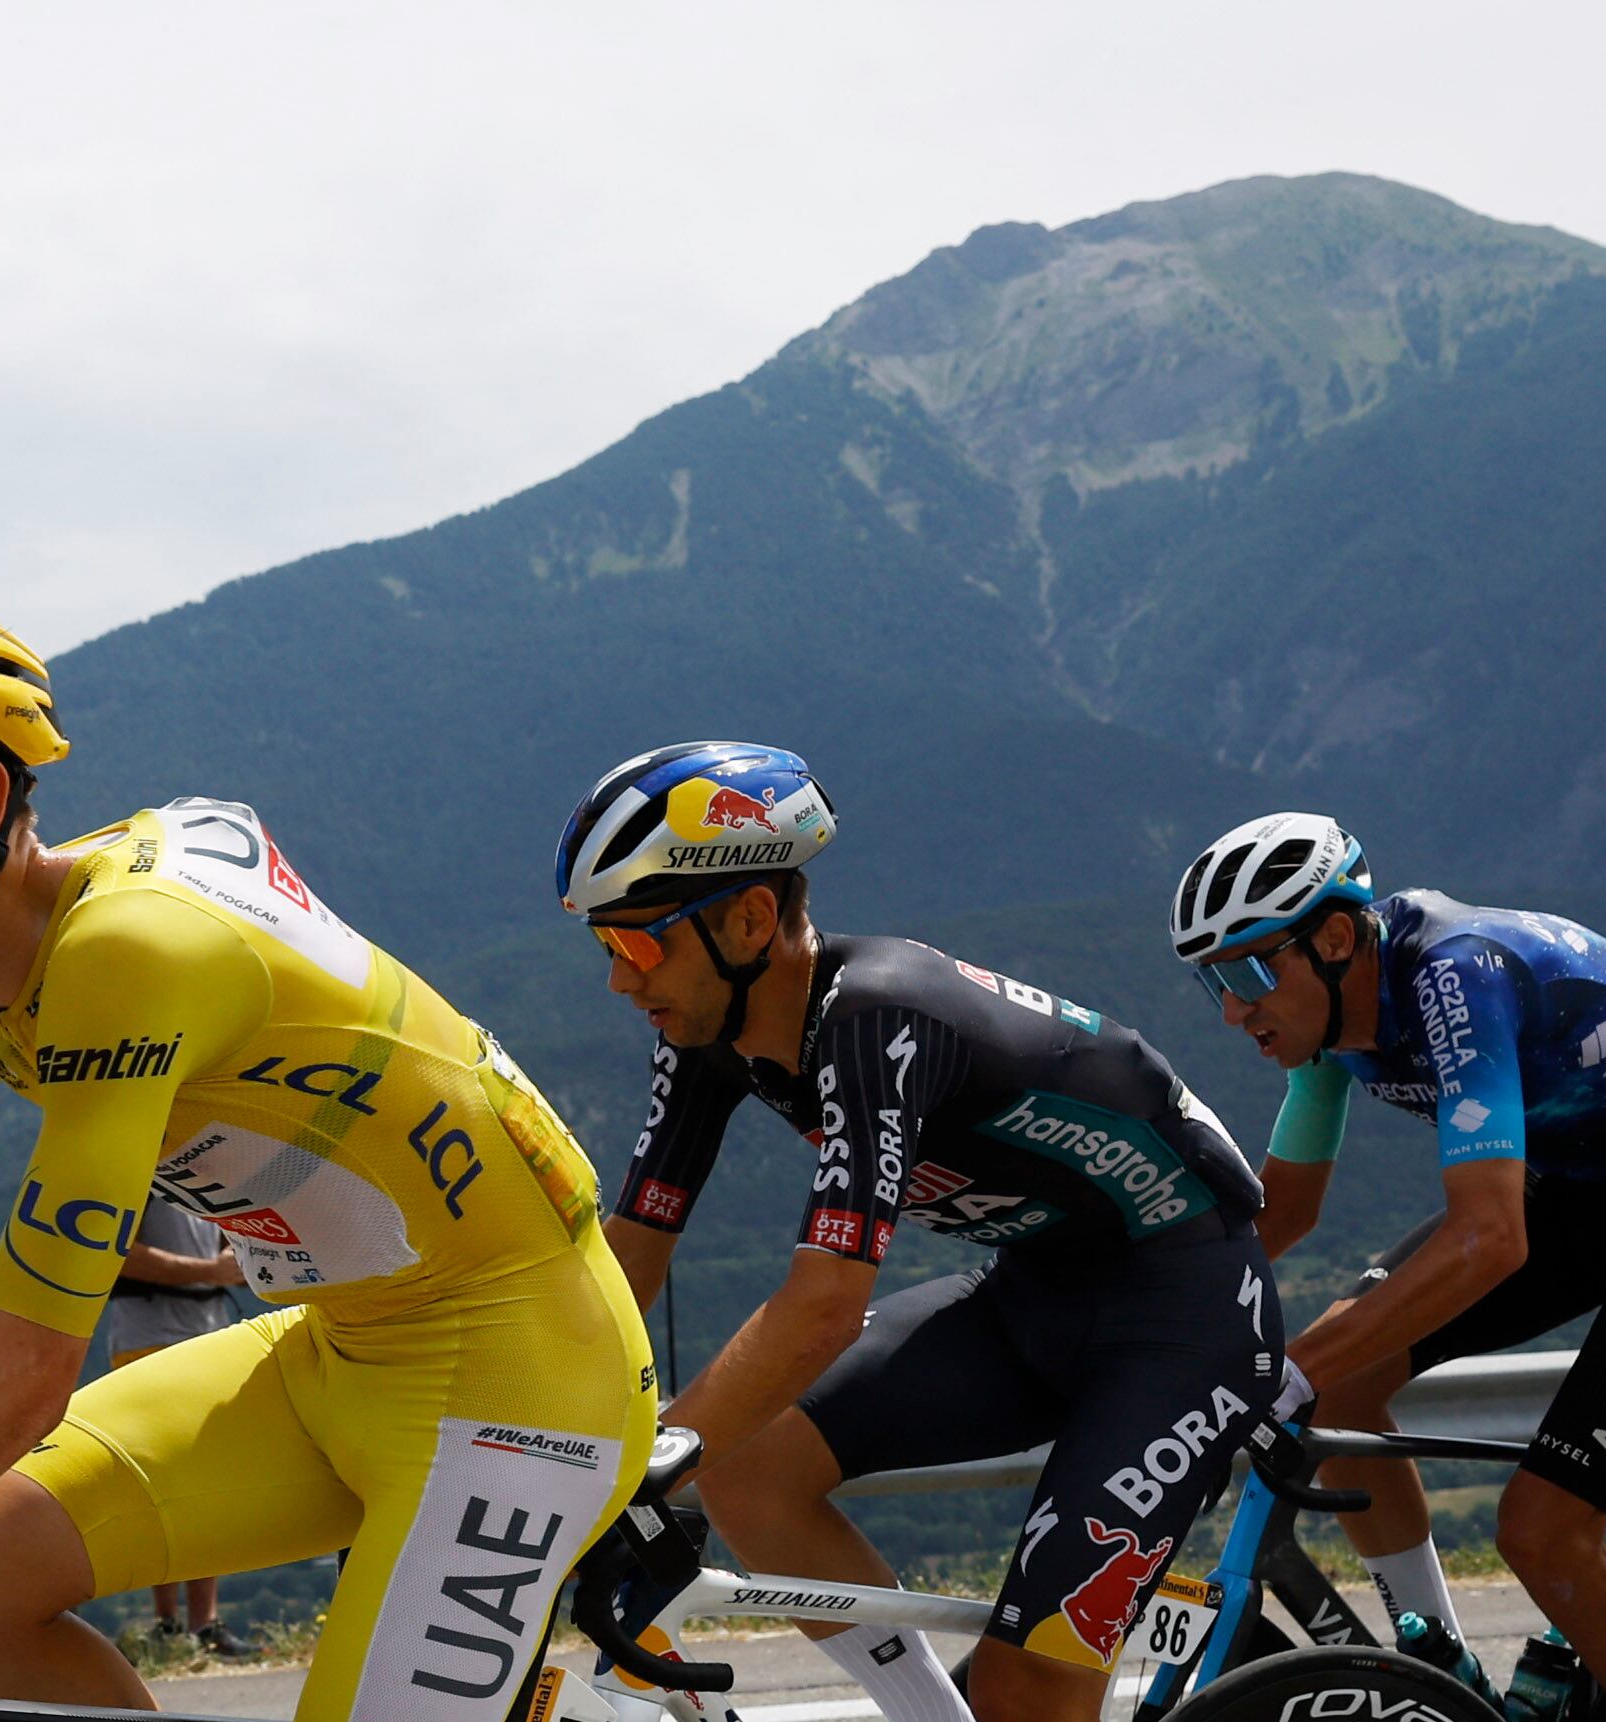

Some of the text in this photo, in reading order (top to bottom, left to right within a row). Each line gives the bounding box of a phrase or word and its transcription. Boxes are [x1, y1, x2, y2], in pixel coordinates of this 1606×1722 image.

[794, 803, 818, 825] BORA
[664, 841, 793, 869] SPECIALIZED
[1310, 855, 1333, 884] VAN
[177, 870, 212, 893] Tadej
[215, 890, 280, 926] POGACAR
[1412, 967, 1463, 1098] MONDIALE
[1430, 957, 1479, 1068] AG2R LA
[37, 1031, 184, 1085] Santini
[238, 1056, 383, 1118] LCL
[633, 1046, 679, 1158] BOSS
[170, 1134, 228, 1170] POGACAR
[812, 1063, 851, 1193] BOSS
[1445, 1139, 1515, 1157] VAN RYSEL
[406, 1099, 484, 1221] LCL
[874, 1108, 904, 1206] BORA
[994, 1095, 1192, 1229] hansgrohe
[18, 1180, 138, 1258] LCL
[643, 1199, 675, 1220] TAL
[645, 1184, 683, 1207] ÖTZ
[814, 1230, 854, 1248] TAL
[816, 1213, 857, 1234] ÖTZ
[1103, 1384, 1250, 1519] BORA
[1540, 1433, 1591, 1467] RYSEL
[410, 1495, 564, 1699] UAE
[723, 1588, 858, 1611] SPECIALIZED
[1149, 1605, 1191, 1658] 86
